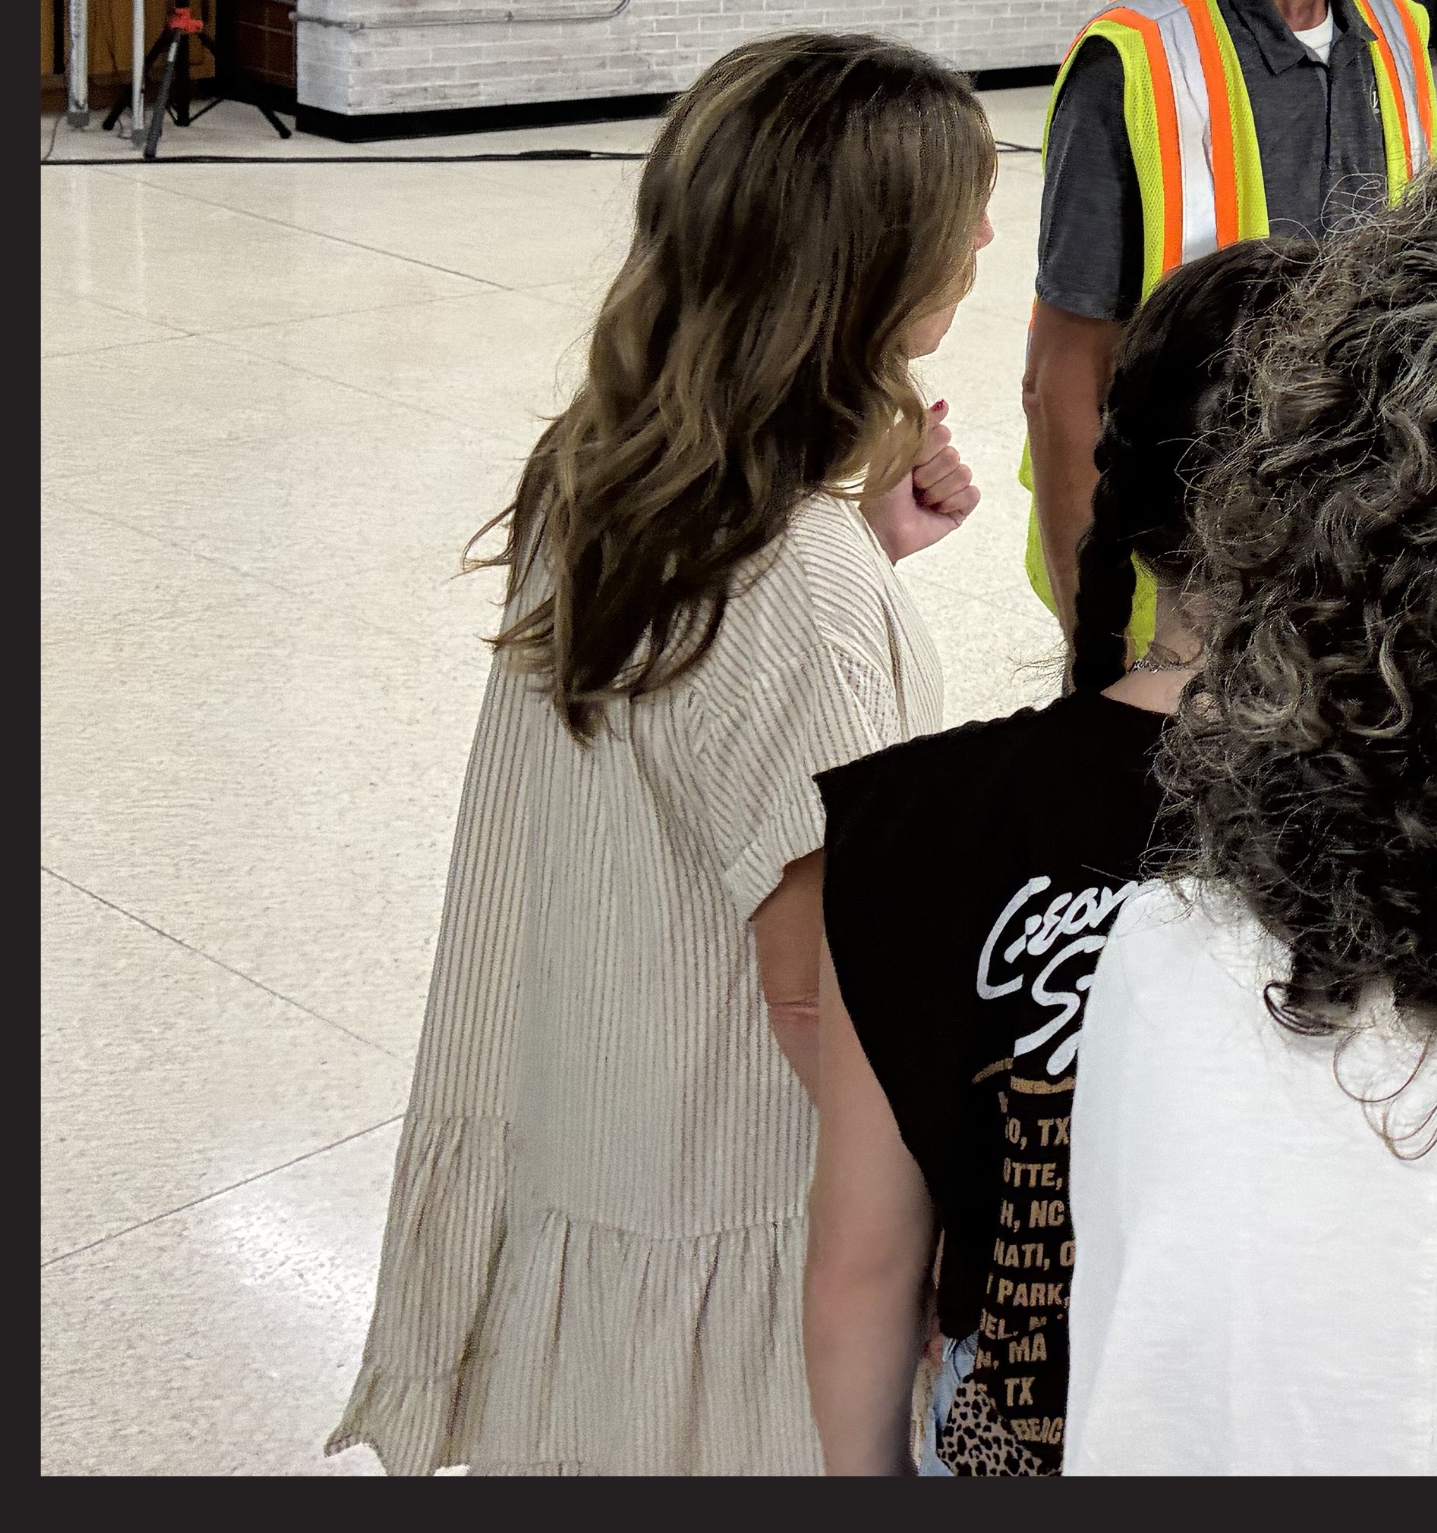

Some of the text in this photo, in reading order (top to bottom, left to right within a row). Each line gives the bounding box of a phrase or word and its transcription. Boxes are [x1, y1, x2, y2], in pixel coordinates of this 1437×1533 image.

[1037, 1116, 1070, 1147] TX
[1029, 1199, 1065, 1228] NC
[1009, 1333, 1047, 1364] MA
[1004, 1376, 1036, 1407] TX
